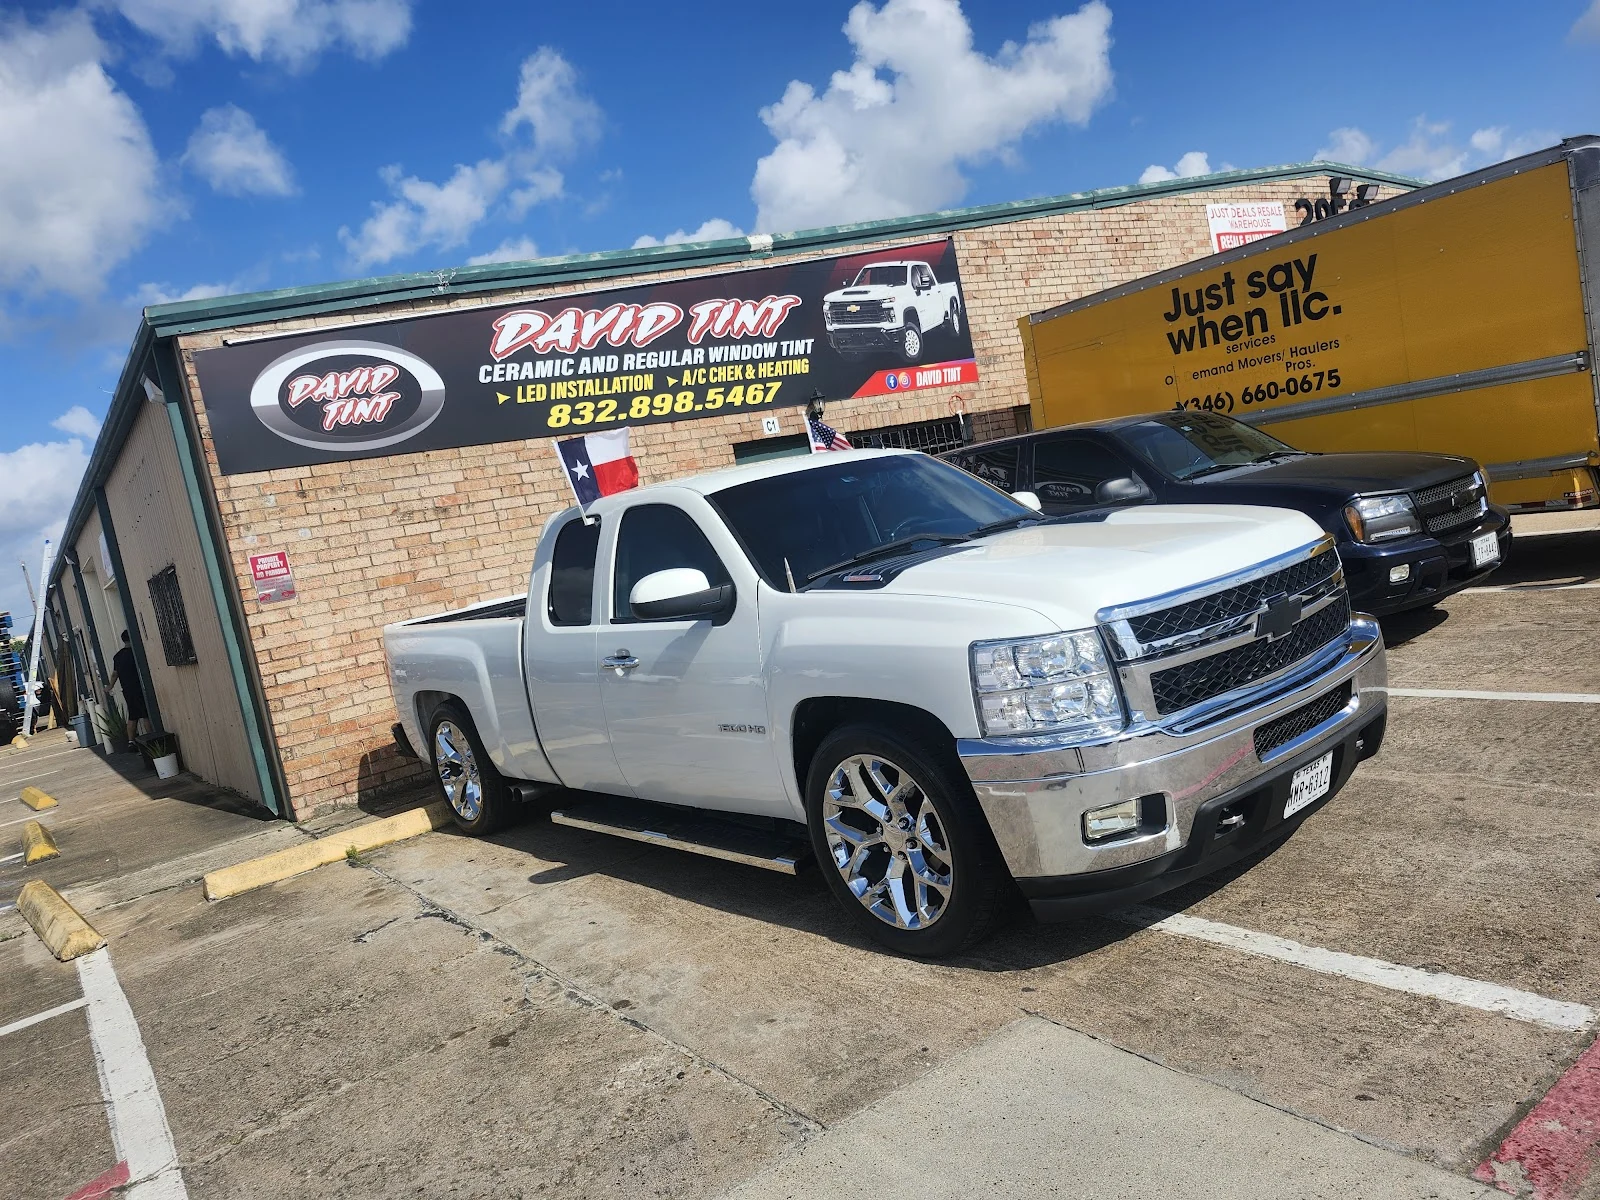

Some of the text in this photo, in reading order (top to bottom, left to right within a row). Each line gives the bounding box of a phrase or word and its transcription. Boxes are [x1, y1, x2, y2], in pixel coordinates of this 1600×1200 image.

[1211, 206, 1282, 219] JUST DEALS RESALE
[1229, 219, 1272, 229] WAREHOUSE
[1163, 253, 1317, 322] Just say
[490, 294, 803, 362] DAVID TINT
[1166, 288, 1342, 355] when llc.
[1226, 334, 1276, 354] services
[1290, 338, 1340, 358] Haulers
[478, 338, 815, 384] CERAMIC AND REGULAR WINDOW TINT
[1285, 358, 1316, 373] Pros.
[288, 364, 399, 408] DAVID
[516, 358, 810, 404] LED INSTALLATION A/C CHEK & HEATING
[916, 369, 942, 387] DAVID
[943, 367, 961, 383] TINT
[1242, 369, 1342, 405] 660-0675
[321, 392, 401, 431] TINT
[547, 381, 783, 429] 832.898.5467
[766, 420, 777, 432] C1
[256, 561, 283, 571] PROPERTY
[1303, 760, 1320, 776] TEXAS
